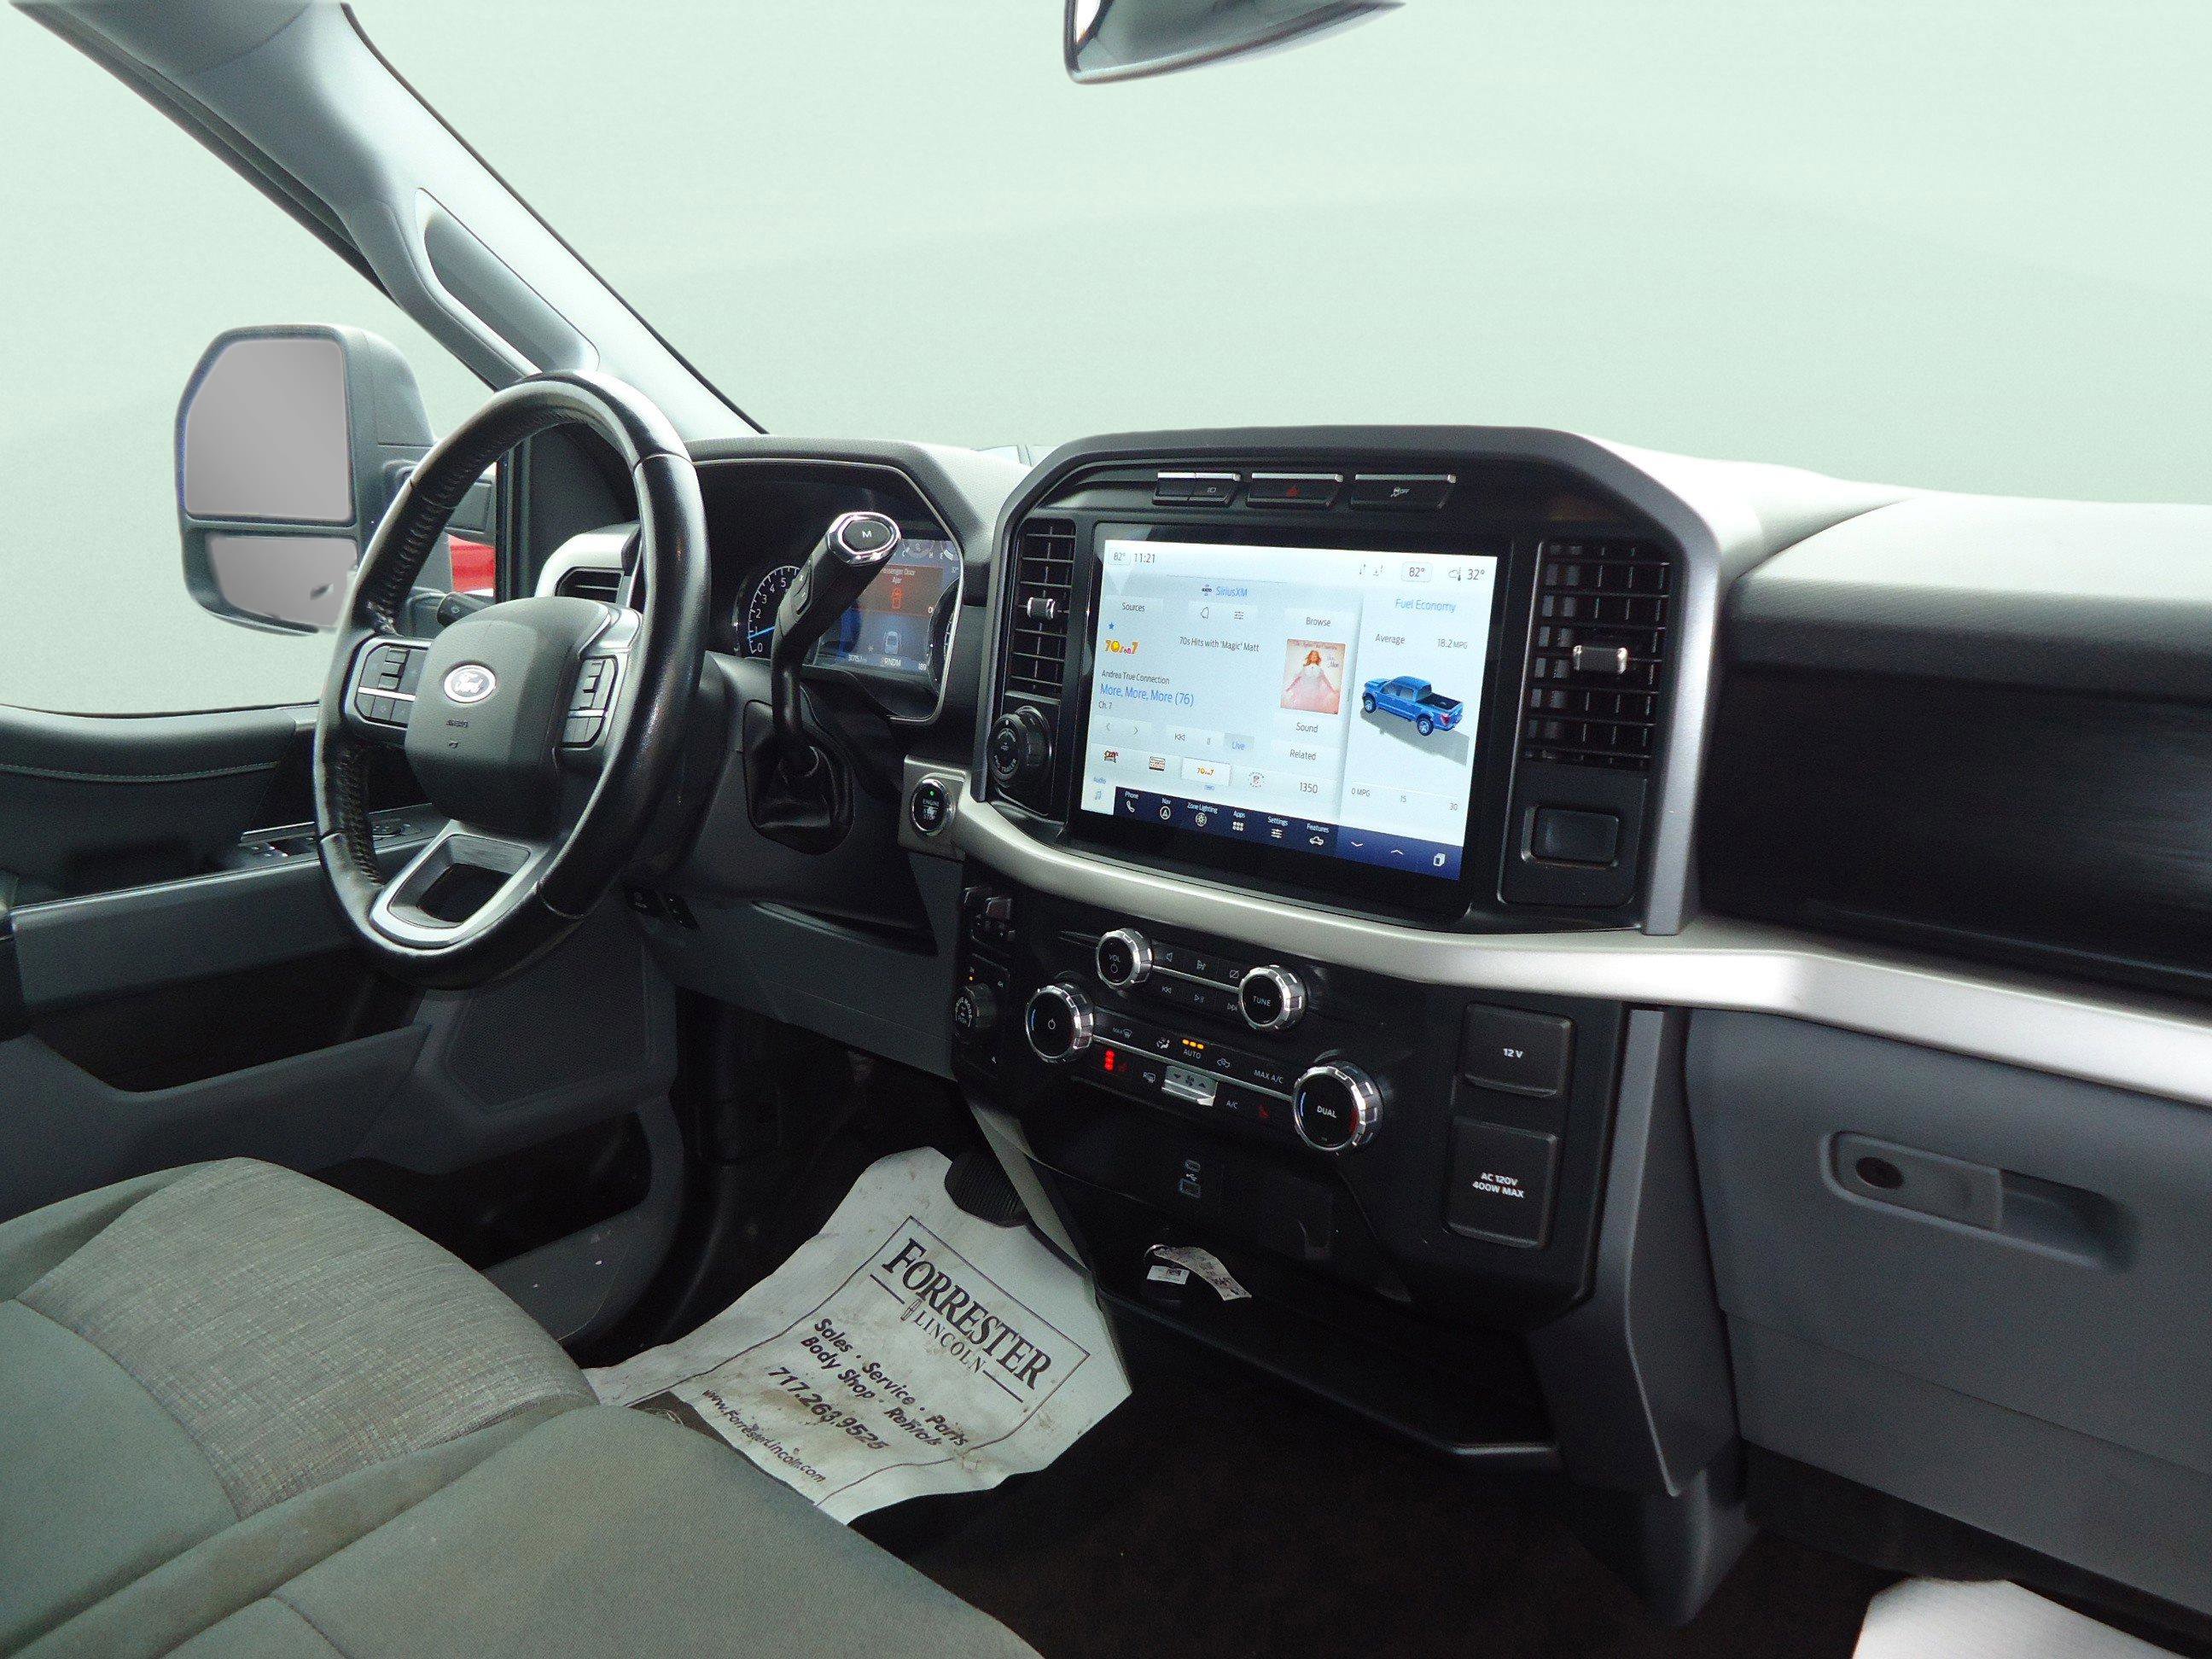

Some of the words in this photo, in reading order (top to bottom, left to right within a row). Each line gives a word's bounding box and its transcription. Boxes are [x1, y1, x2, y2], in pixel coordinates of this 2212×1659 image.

[1133, 553, 1156, 564] 11:21
[1409, 567, 1425, 578] 82°
[1467, 569, 1486, 580] 32°
[780, 577, 787, 588] 5
[769, 584, 775, 593] 4
[1215, 586, 1249, 597] SiriusXM
[761, 594, 767, 604] 3
[1121, 602, 1146, 614] Sources
[1395, 598, 1414, 609] Fuel
[1416, 599, 1457, 614] Economy
[756, 608, 761, 619] 2
[1306, 616, 1331, 627] Browse
[1179, 636, 1190, 647] 70s
[1190, 637, 1204, 648] Hits
[1204, 638, 1219, 649] with
[1243, 642, 1260, 652] Matt
[1376, 634, 1406, 645] Average
[1452, 640, 1468, 649] MPG
[757, 643, 763, 653] 0
[1101, 669, 1122, 680] Andrea
[1122, 671, 1136, 681] True
[1136, 673, 1170, 685] Connection
[1100, 684, 1123, 698] More,
[1125, 686, 1148, 700] More,
[1150, 690, 1173, 703] More
[1174, 692, 1195, 707] (76)
[1098, 700, 1109, 710] Ch.
[1295, 722, 1318, 733] Sound
[1231, 740, 1246, 751] Live
[1289, 749, 1317, 761] Related
[1300, 782, 1318, 795] 1350
[1356, 789, 1371, 798] MPG
[1124, 790, 1139, 800] Phone
[1187, 802, 1200, 811] Zone
[1200, 804, 1219, 815] Lighting
[1449, 802, 1458, 812] 30
[1234, 810, 1246, 819] Apps
[1267, 816, 1289, 827] Settings
[1307, 823, 1330, 834] Features
[1109, 954, 1121, 963] VOL
[1252, 995, 1272, 1007] TUNE
[1184, 1048, 1202, 1059] AUTO
[1503, 1047, 1514, 1057] 12
[1515, 1050, 1523, 1059] V
[1254, 1069, 1269, 1080] MAX
[1270, 1073, 1284, 1085] A/C
[1226, 1099, 1239, 1110] A/C
[1317, 1106, 1337, 1119] DUAL
[1481, 1172, 1493, 1182] AC
[1494, 1173, 1518, 1187] 120V
[1472, 1180, 1500, 1194] 400W
[1502, 1185, 1524, 1198] MAX
[882, 1237, 1053, 1392] FORRESTER
[912, 1309, 987, 1375] LINCOLN
[800, 1336, 841, 1371] Body
[837, 1368, 876, 1400] Shop
[814, 1318, 853, 1353] Sales
[861, 1361, 917, 1406] Service
[924, 1413, 969, 1447] Parts
